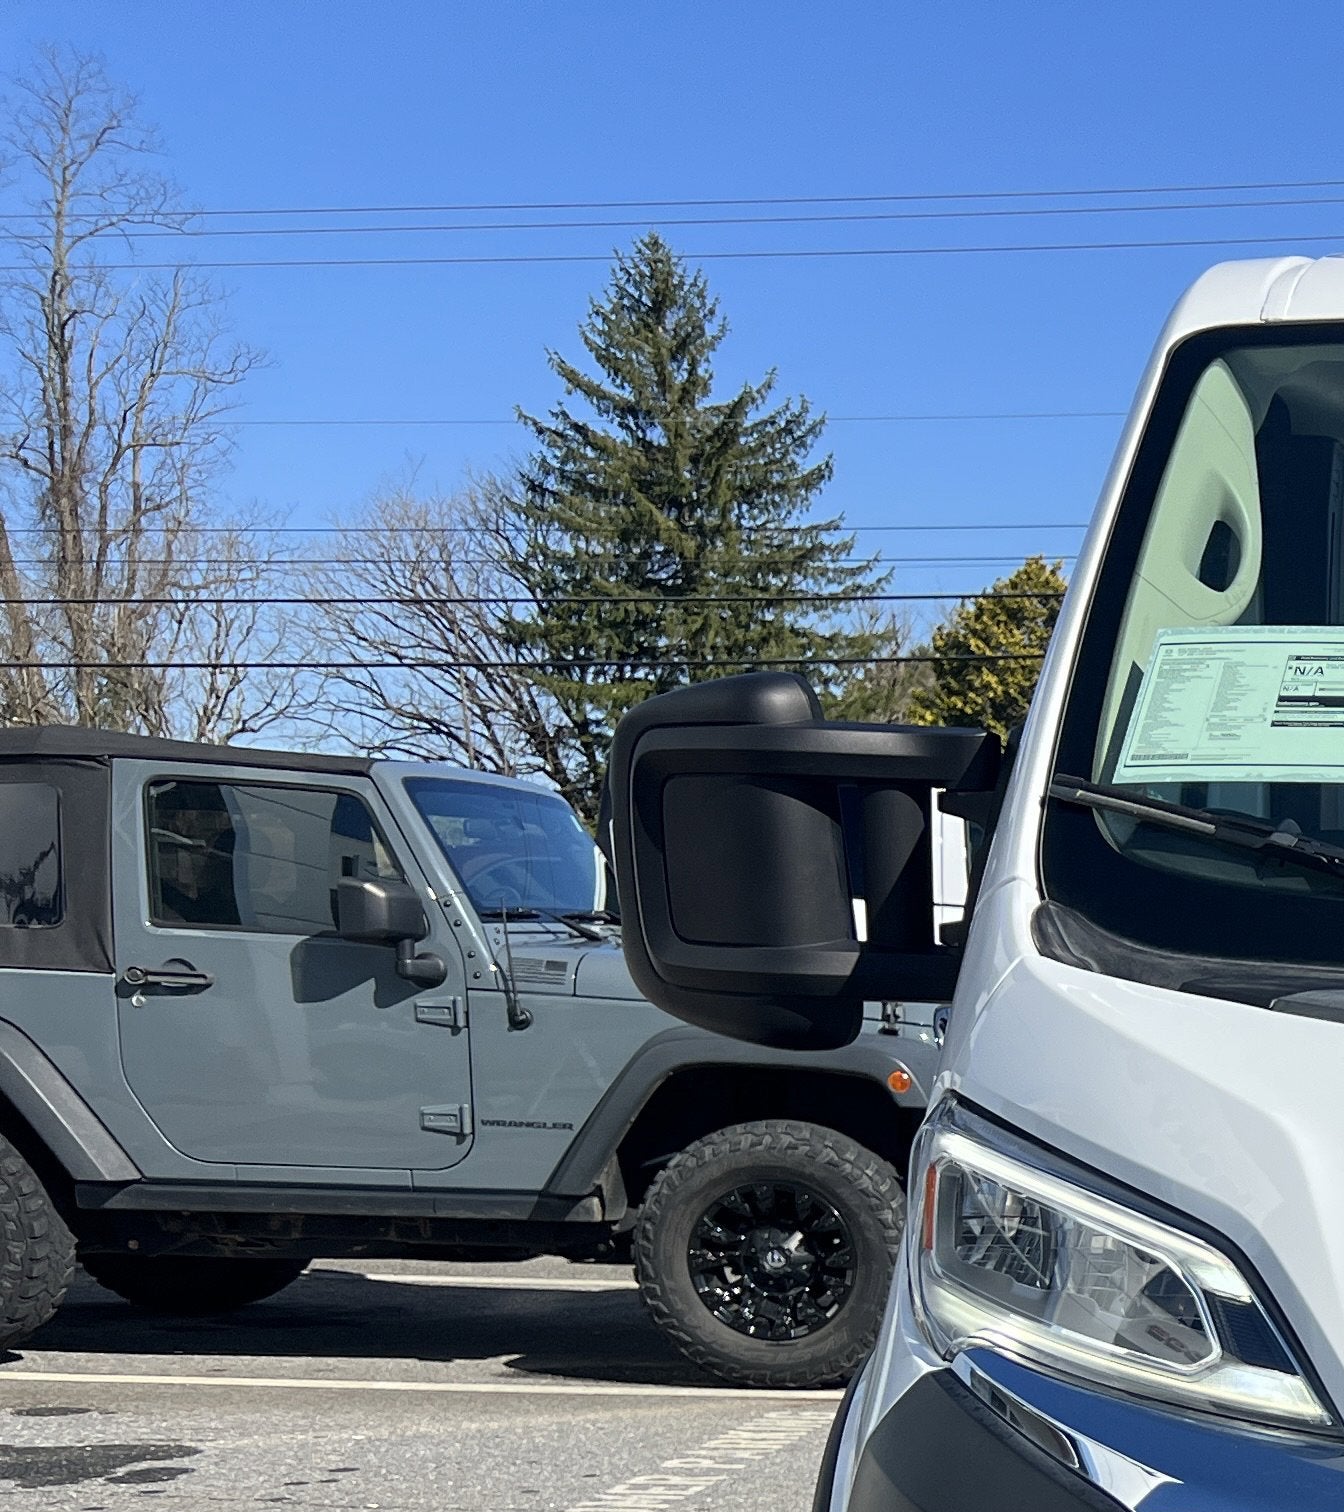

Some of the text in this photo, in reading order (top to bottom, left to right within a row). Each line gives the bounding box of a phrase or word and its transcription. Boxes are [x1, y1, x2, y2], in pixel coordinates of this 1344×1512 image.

[1293, 666, 1325, 676] N/A
[481, 1119, 575, 1131] WRANGLER
[661, 1411, 836, 1468] PARKING
